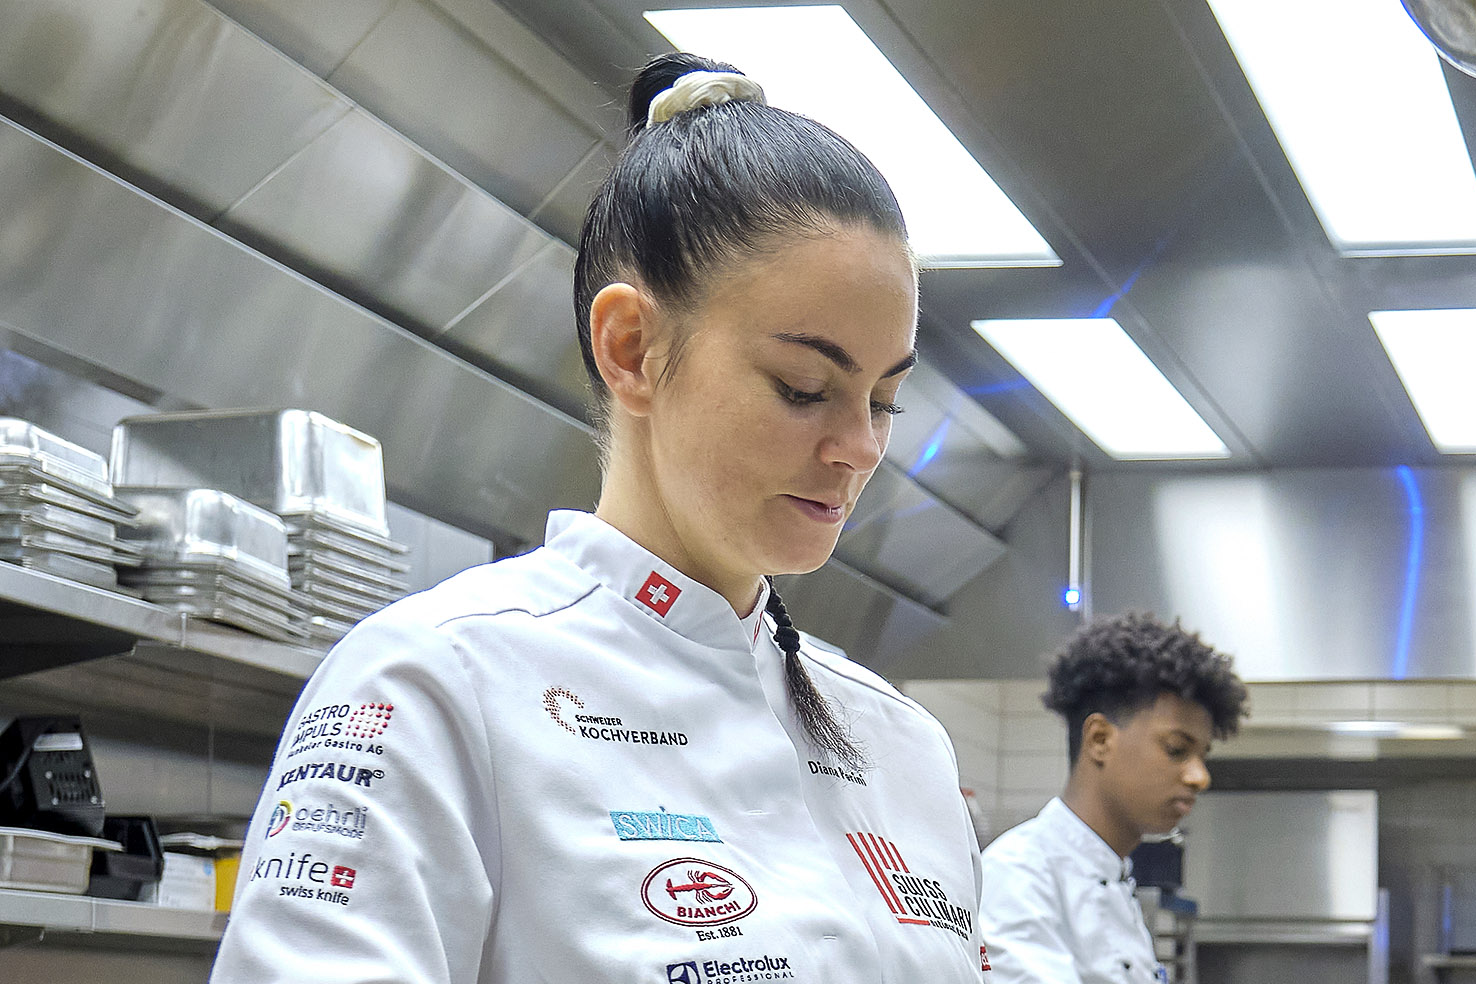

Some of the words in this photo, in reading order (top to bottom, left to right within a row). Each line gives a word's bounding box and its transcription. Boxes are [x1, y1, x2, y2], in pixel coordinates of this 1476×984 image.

[575, 714, 623, 726] SCHWEIZER
[579, 725, 688, 746] KOCHVERBAND
[324, 739, 363, 752] Gastro
[366, 744, 384, 755] AG
[619, 813, 720, 839] SWICA
[279, 885, 313, 899] swiss
[316, 888, 350, 906] knife
[892, 873, 947, 901] SWISS
[677, 900, 742, 918] BIANCHI
[904, 895, 973, 934] CULINARY
[703, 955, 791, 978] Electrolux
